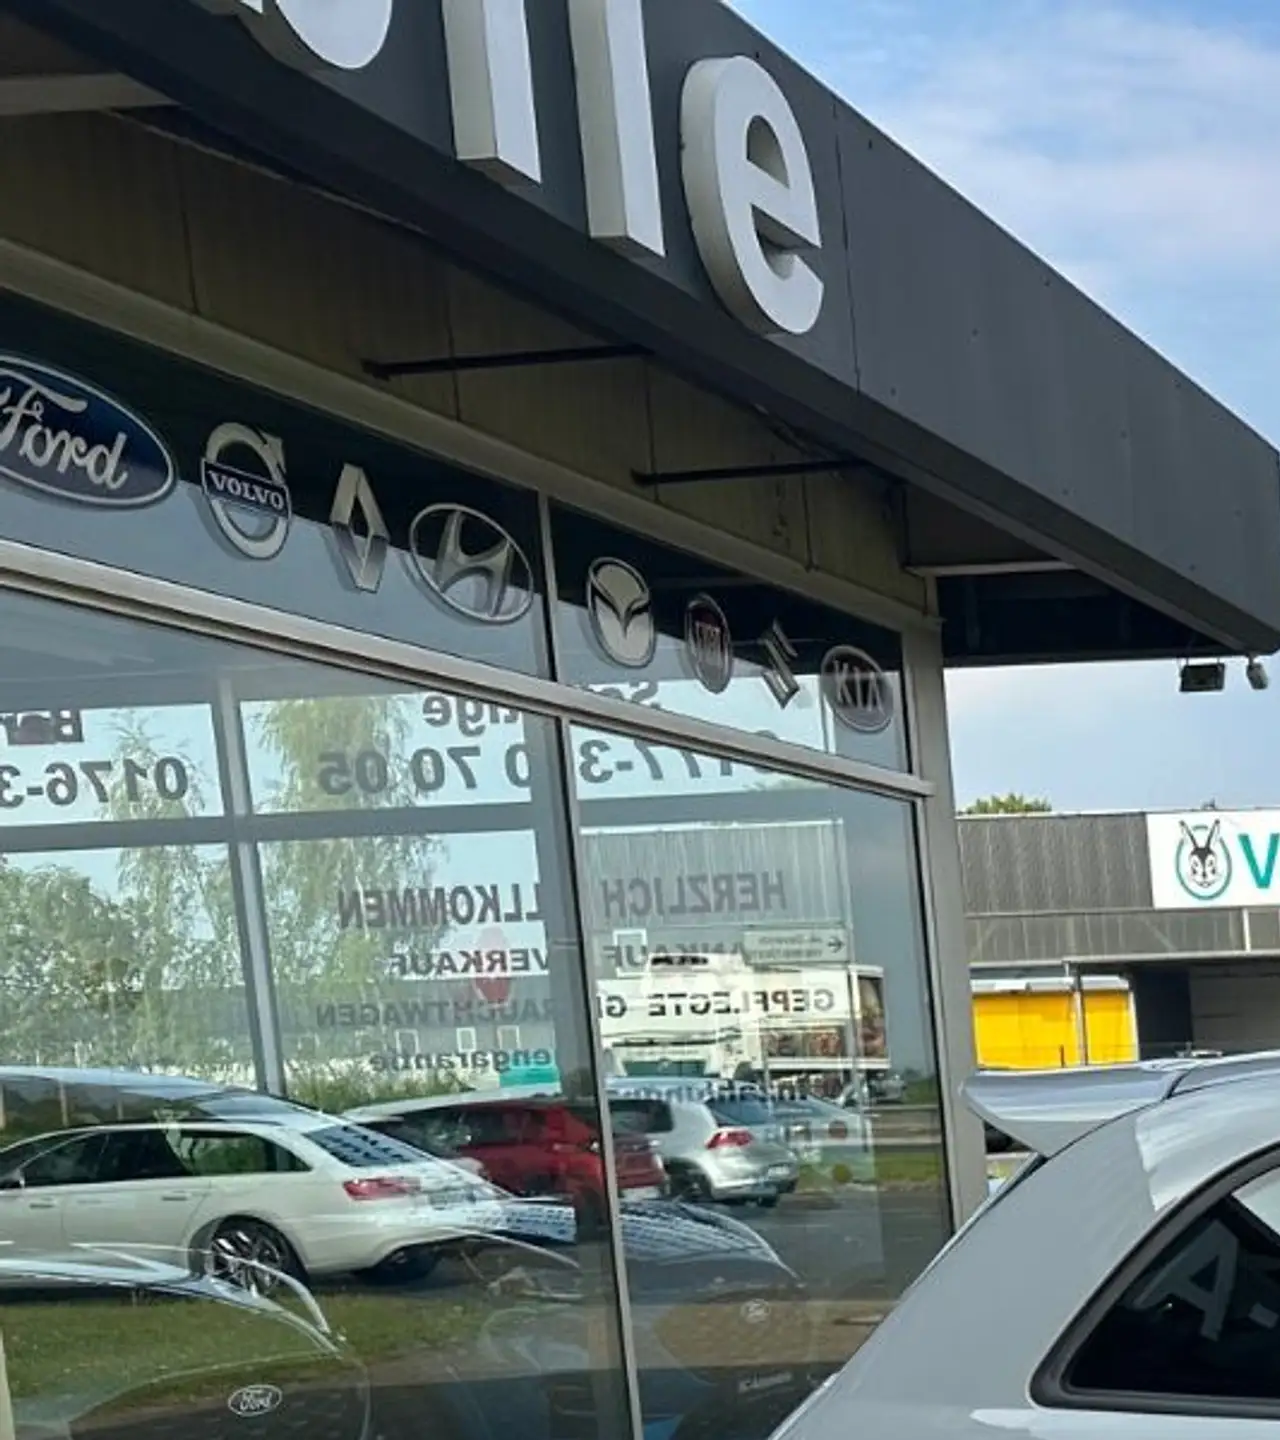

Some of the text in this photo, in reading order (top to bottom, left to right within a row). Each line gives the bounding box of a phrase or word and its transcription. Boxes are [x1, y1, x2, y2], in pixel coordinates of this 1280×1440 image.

[0, 368, 129, 489] Ford
[207, 469, 285, 510] VOLVO
[833, 659, 884, 715] KIA
